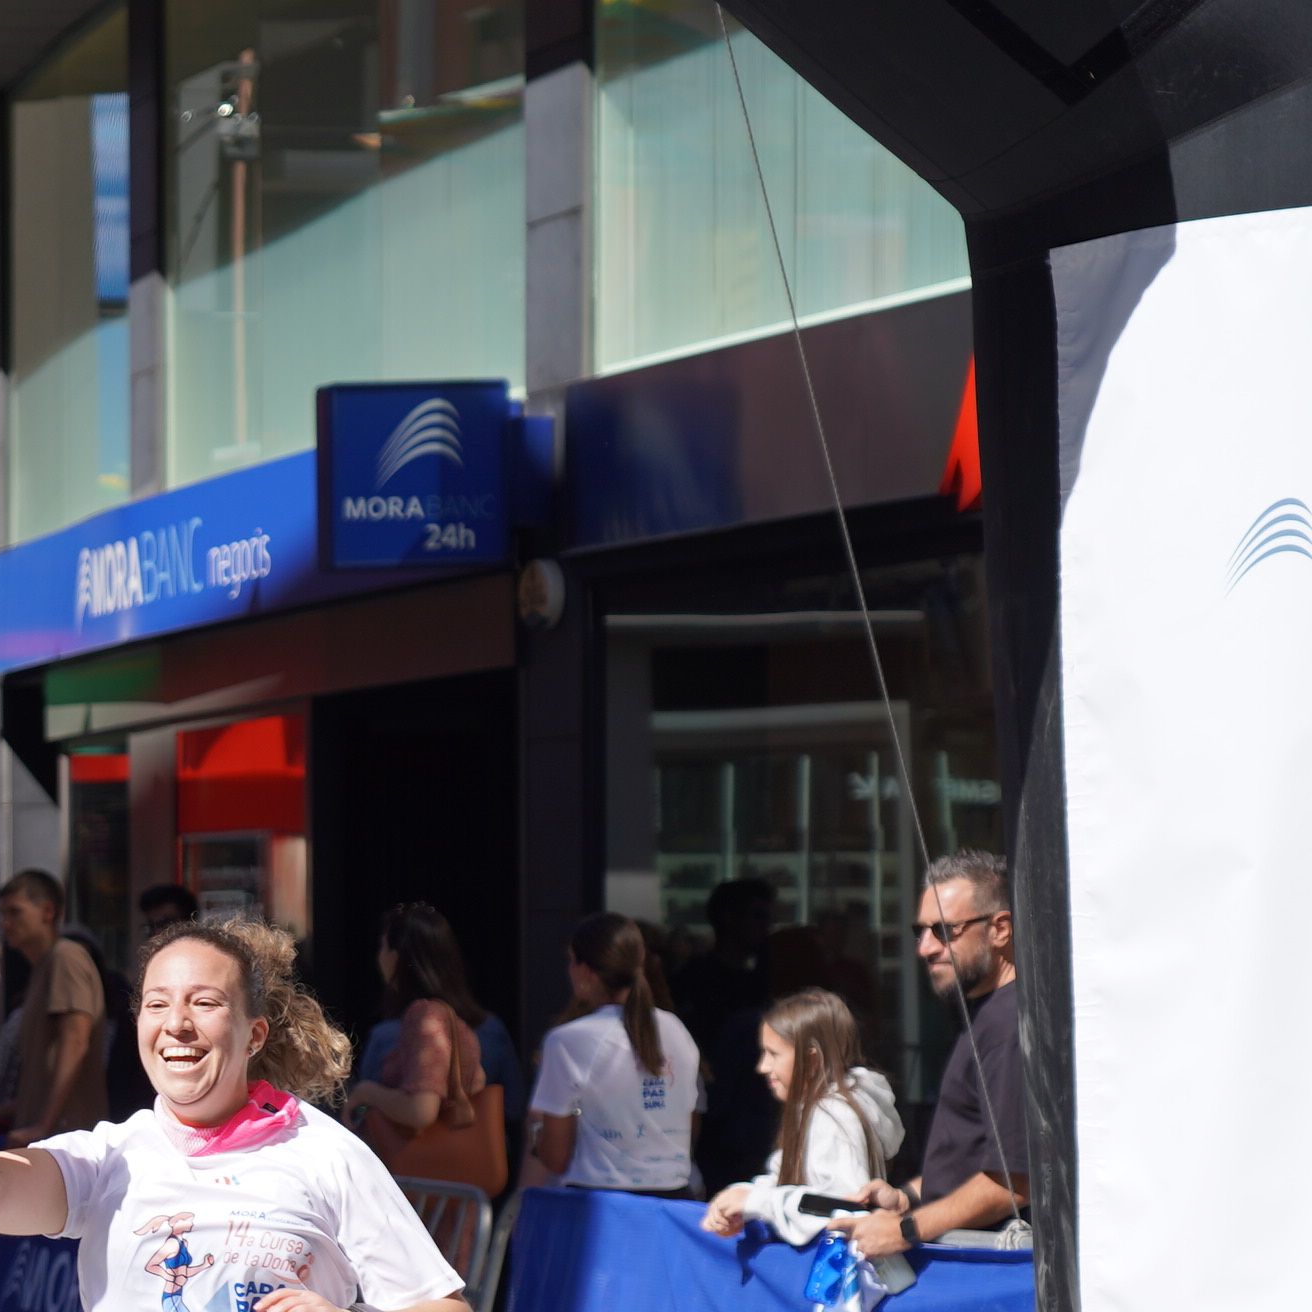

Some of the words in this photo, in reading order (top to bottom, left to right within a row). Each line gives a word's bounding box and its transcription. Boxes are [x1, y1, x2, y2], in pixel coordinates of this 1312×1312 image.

[423, 522, 476, 552] 24h
[206, 526, 272, 600] negocis
[259, 1231, 305, 1256] Cursa
[244, 1250, 261, 1267] la
[262, 1252, 297, 1272] Dona
